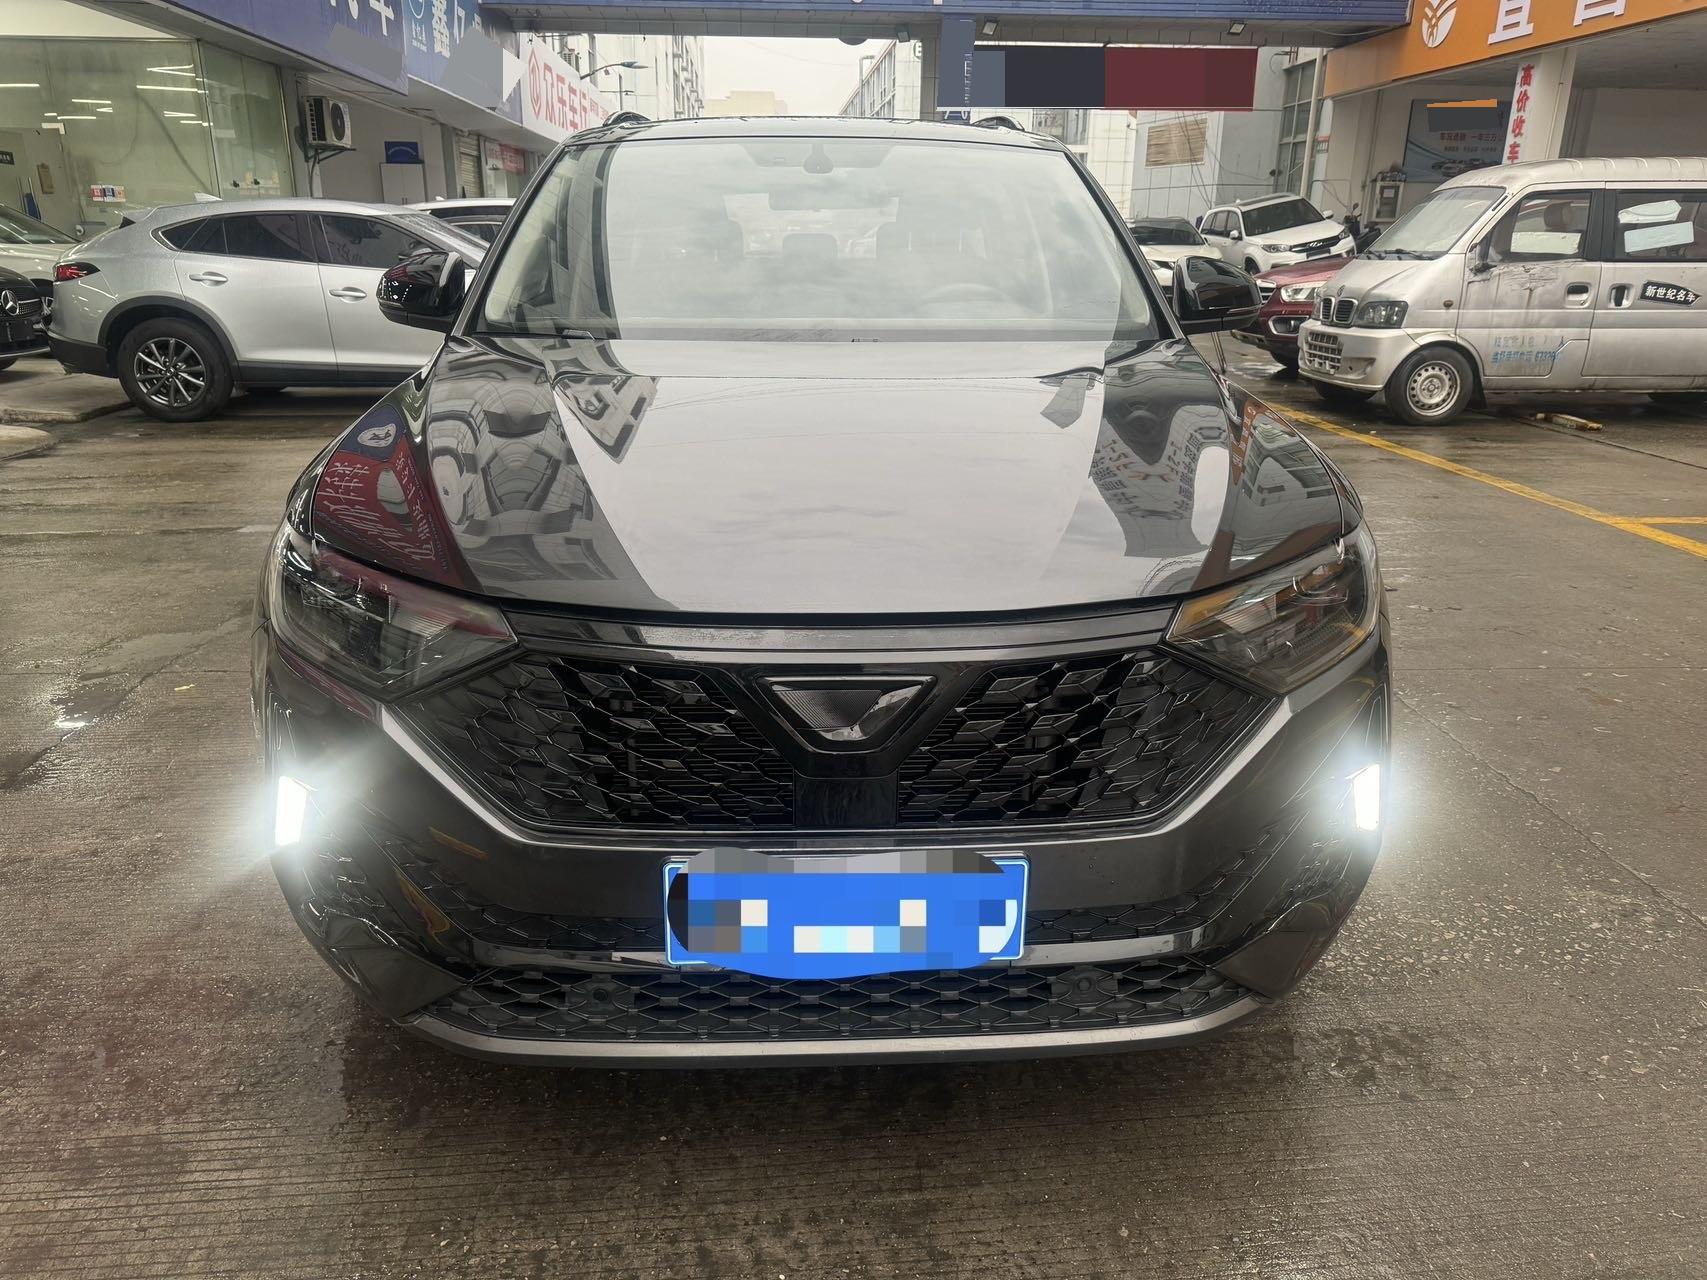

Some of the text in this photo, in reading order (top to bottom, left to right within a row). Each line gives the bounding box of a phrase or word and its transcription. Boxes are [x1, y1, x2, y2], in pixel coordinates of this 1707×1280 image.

[1507, 63, 1535, 164] 高价收车
[1644, 284, 1696, 302] 新世纪名车
